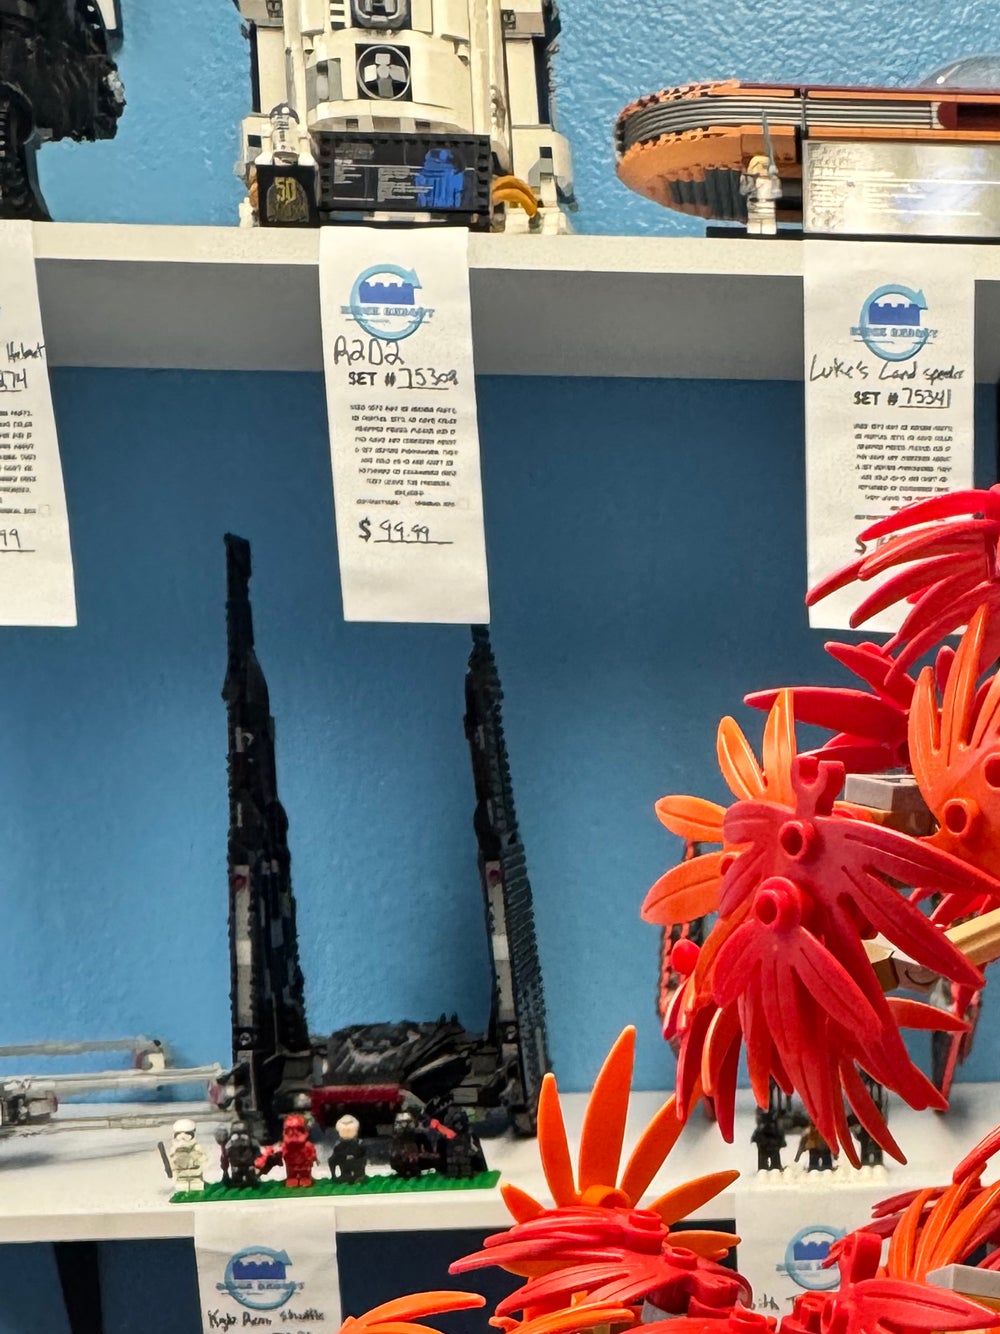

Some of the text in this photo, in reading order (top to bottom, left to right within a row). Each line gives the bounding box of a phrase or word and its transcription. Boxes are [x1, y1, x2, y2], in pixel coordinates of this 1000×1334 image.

[333, 335, 405, 366] R2D2
[810, 354, 869, 381] Luke's
[878, 361, 917, 380] Land
[349, 371, 377, 385] SET
[853, 391, 881, 405] SET
